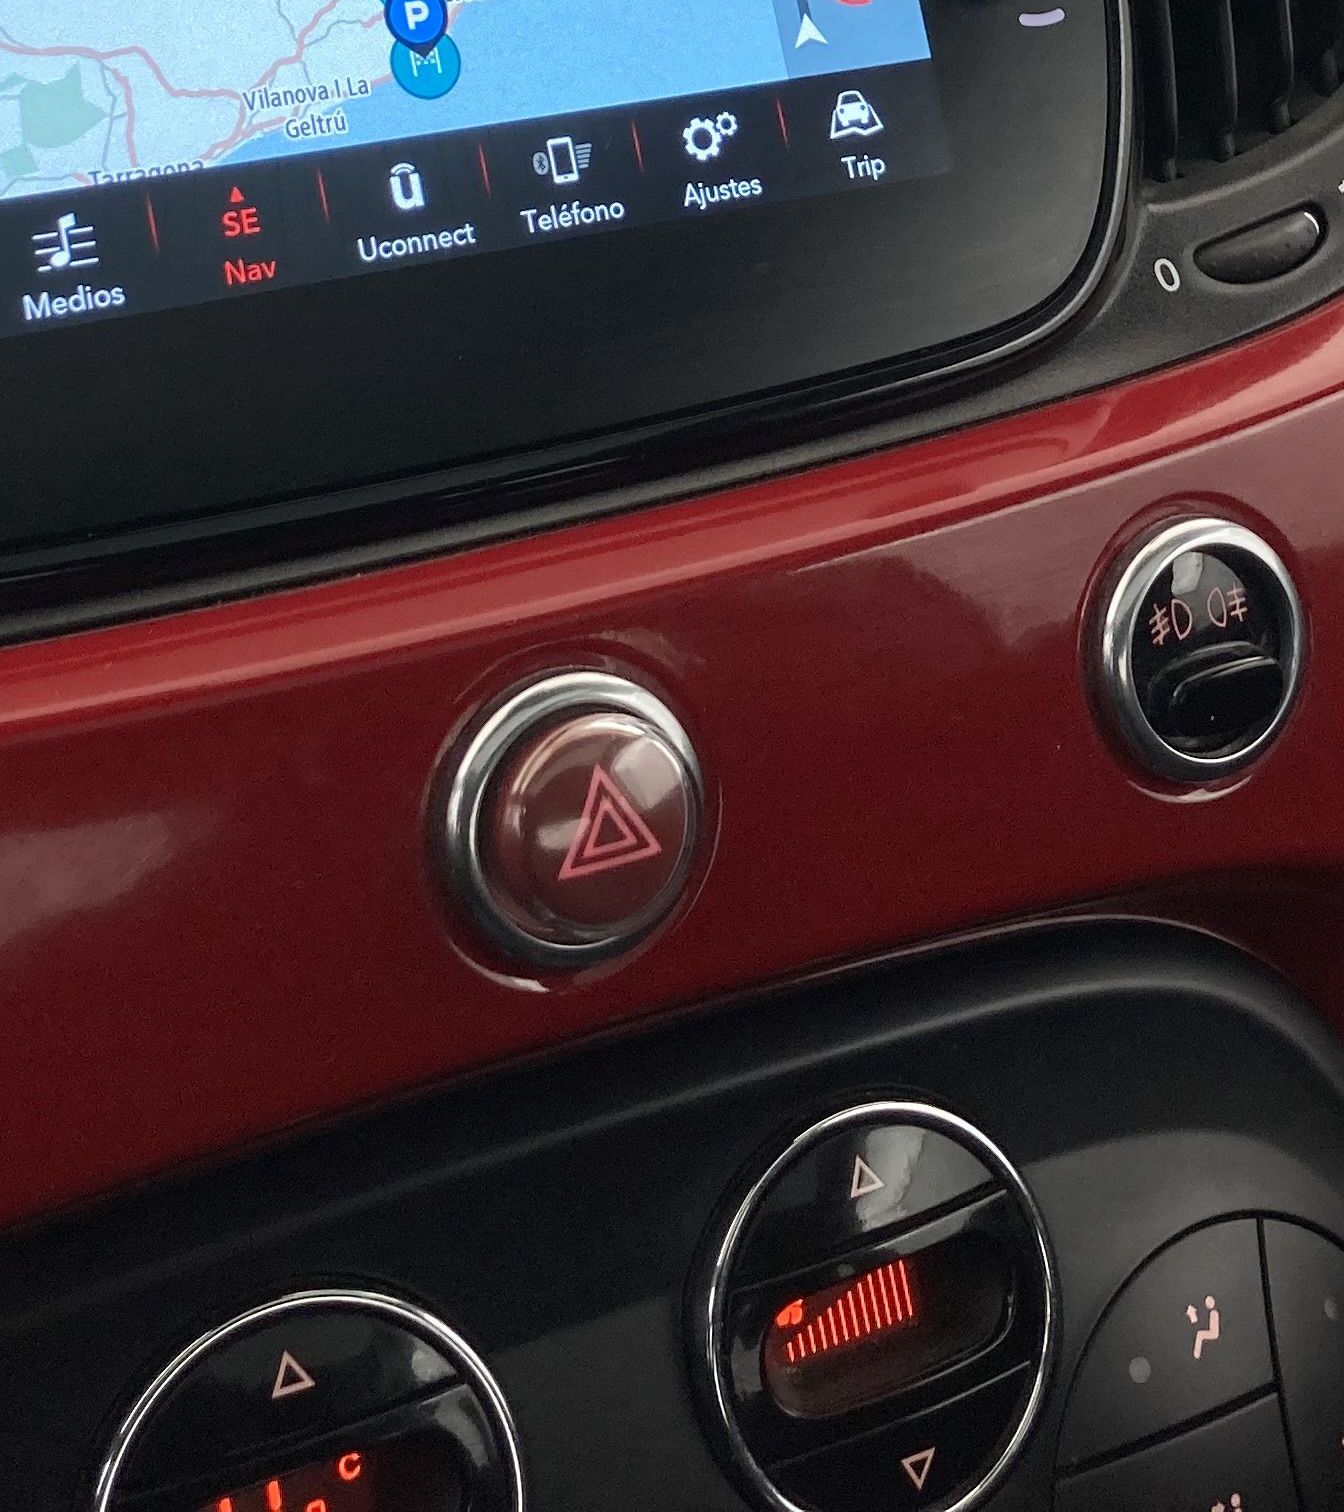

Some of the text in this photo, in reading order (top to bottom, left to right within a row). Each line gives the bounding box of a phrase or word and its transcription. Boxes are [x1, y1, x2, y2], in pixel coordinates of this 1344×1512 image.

[242, 85, 329, 111] Vilanova
[347, 77, 369, 97] La
[286, 110, 347, 138] Geltrú
[841, 153, 886, 181] Trip
[684, 176, 763, 210] Ajustes
[222, 207, 261, 237] SE
[520, 201, 625, 234] Teléfono
[357, 223, 477, 262] Uconnect
[223, 259, 276, 286] Nav
[1154, 258, 1180, 292] 0
[23, 283, 126, 321] Medios
